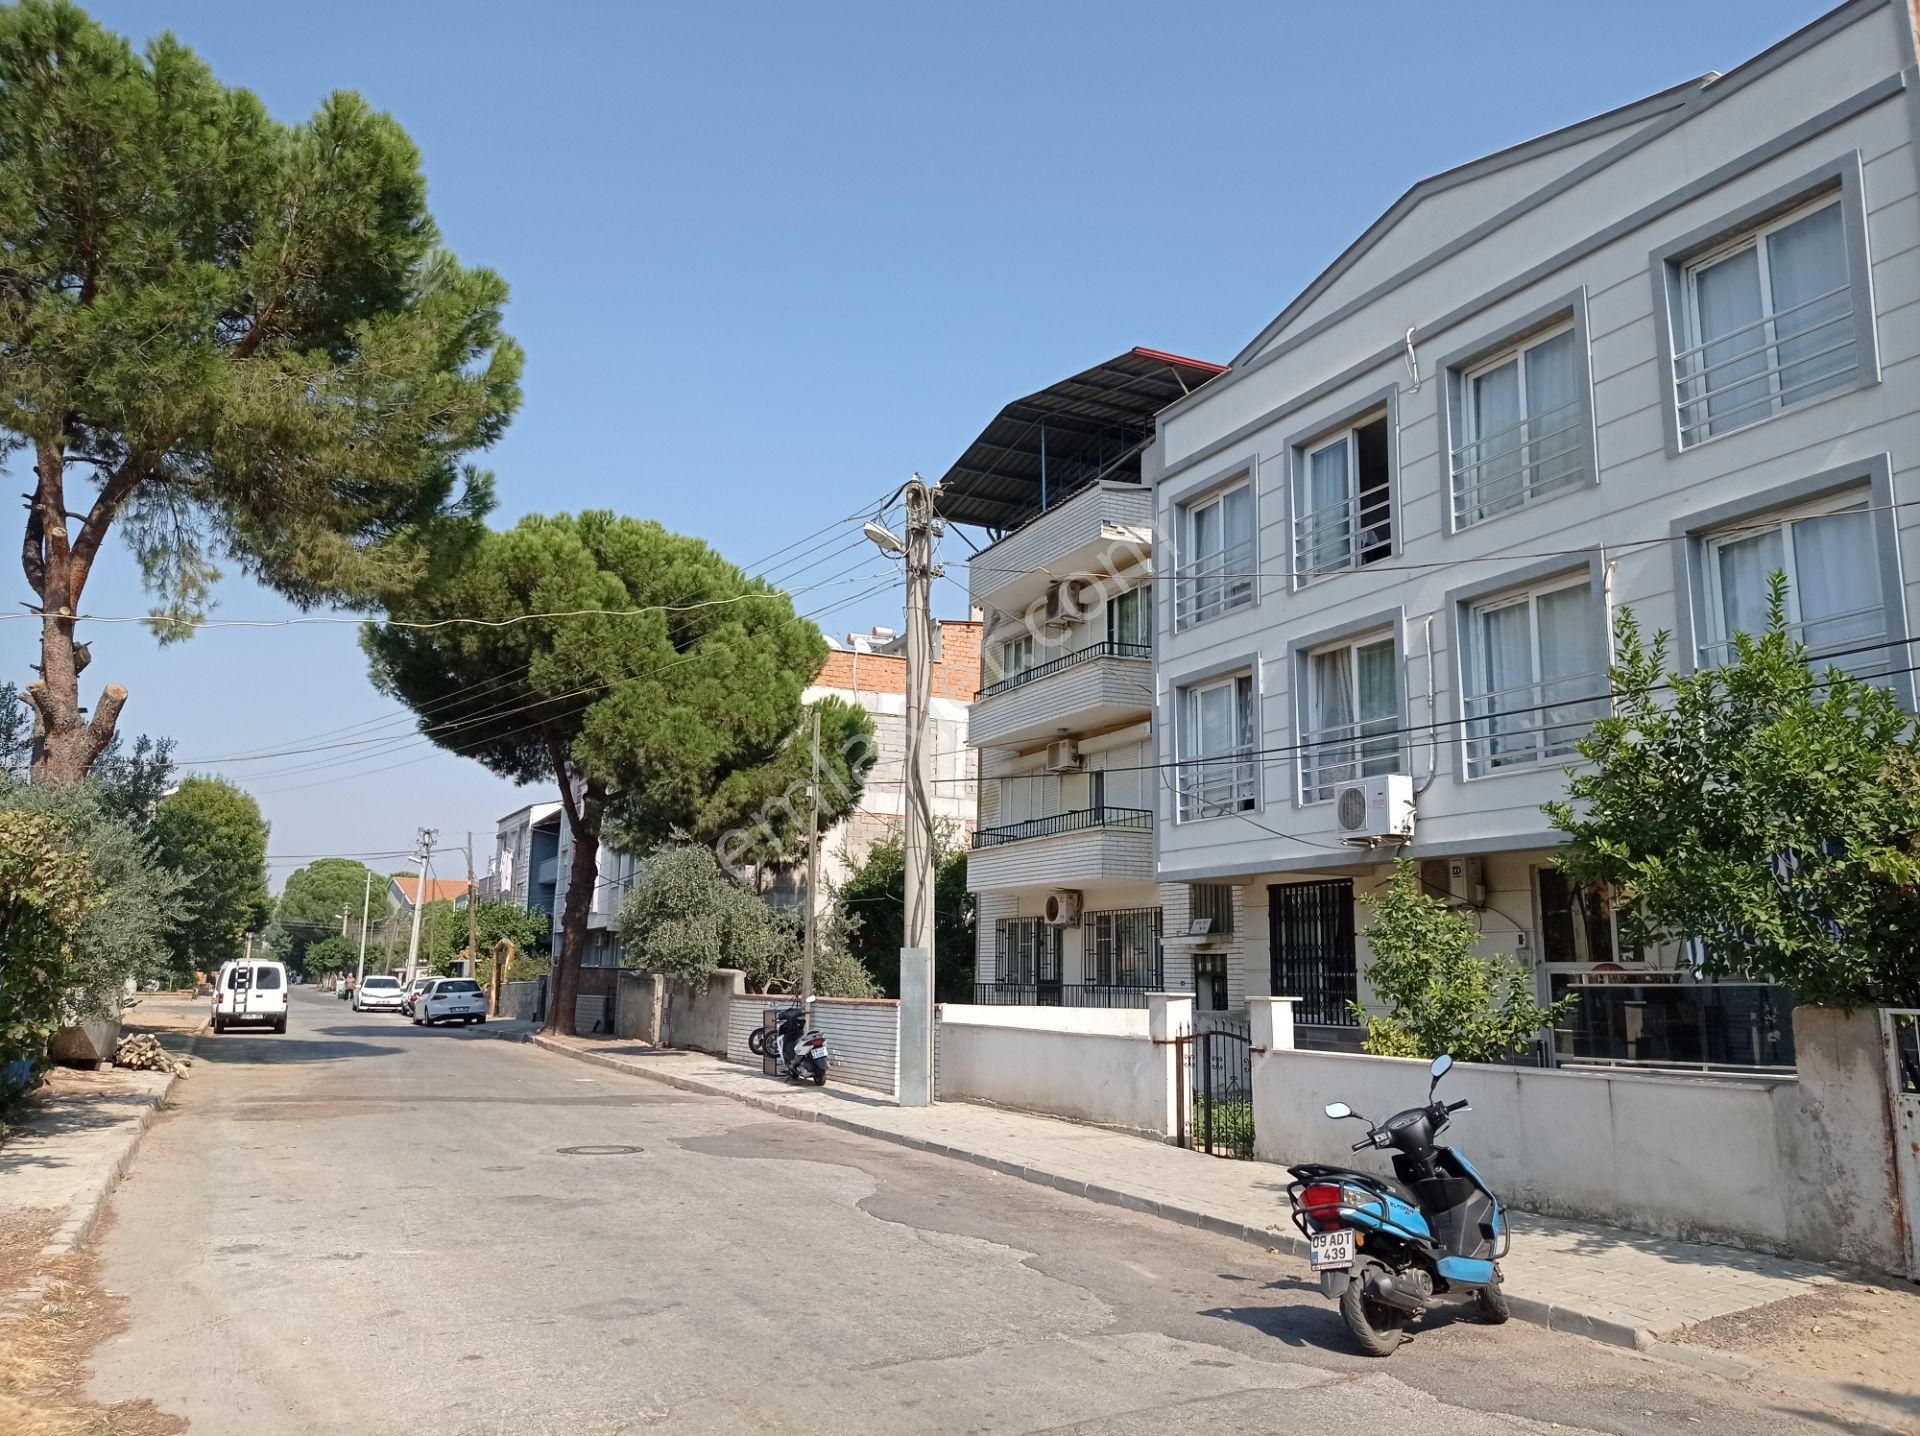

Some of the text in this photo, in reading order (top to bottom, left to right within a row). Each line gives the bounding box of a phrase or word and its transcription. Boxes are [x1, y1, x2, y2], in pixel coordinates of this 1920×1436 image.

[1312, 1232, 1351, 1249] 09 ADT
[1324, 1247, 1346, 1260] 439
